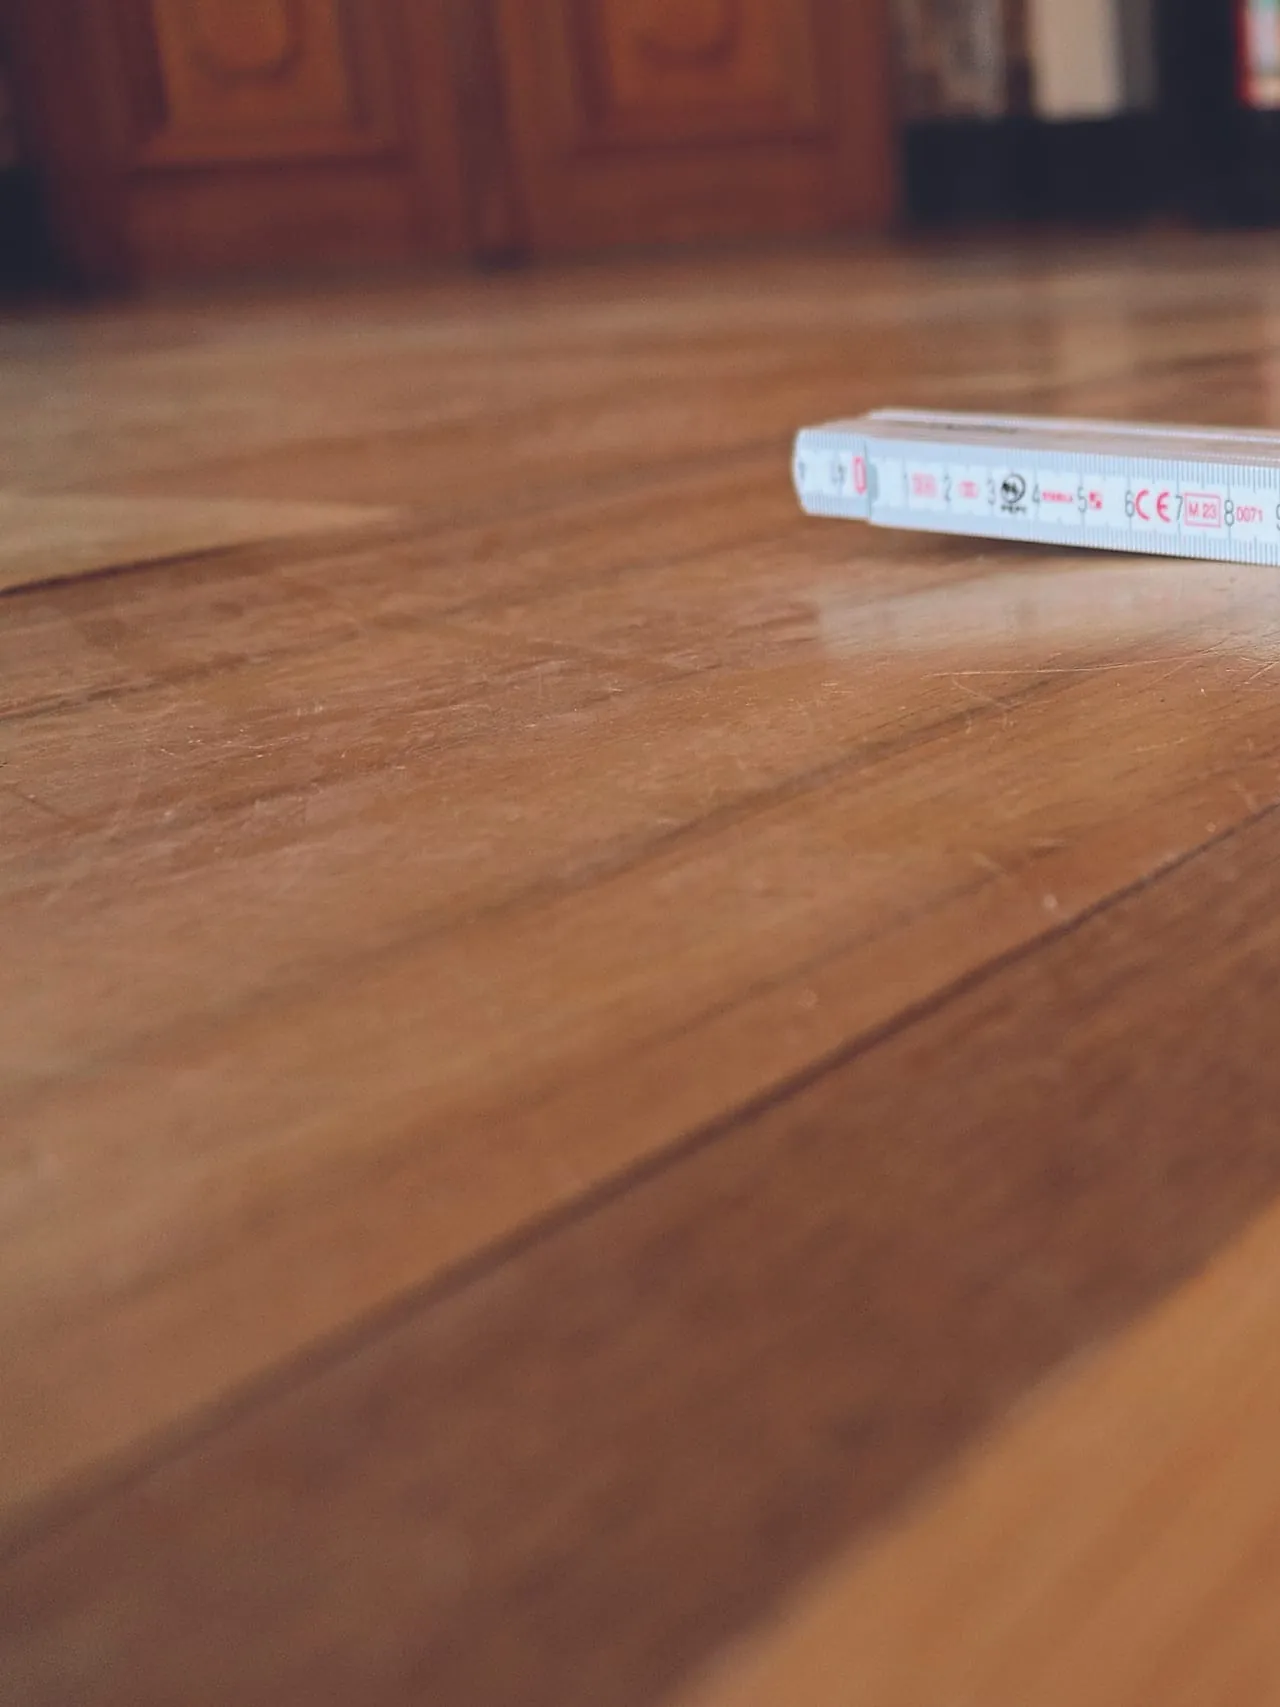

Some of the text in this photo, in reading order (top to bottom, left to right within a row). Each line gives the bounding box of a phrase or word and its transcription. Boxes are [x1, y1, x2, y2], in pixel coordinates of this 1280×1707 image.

[1031, 476, 1042, 504] 4
[1076, 486, 1088, 513] 5
[1124, 490, 1135, 518] 6
[1175, 495, 1185, 521] 7
[1224, 500, 1236, 528] 8
[1188, 502, 1199, 517] M
[1202, 503, 1217, 519] 23
[1236, 508, 1263, 522] 0071
